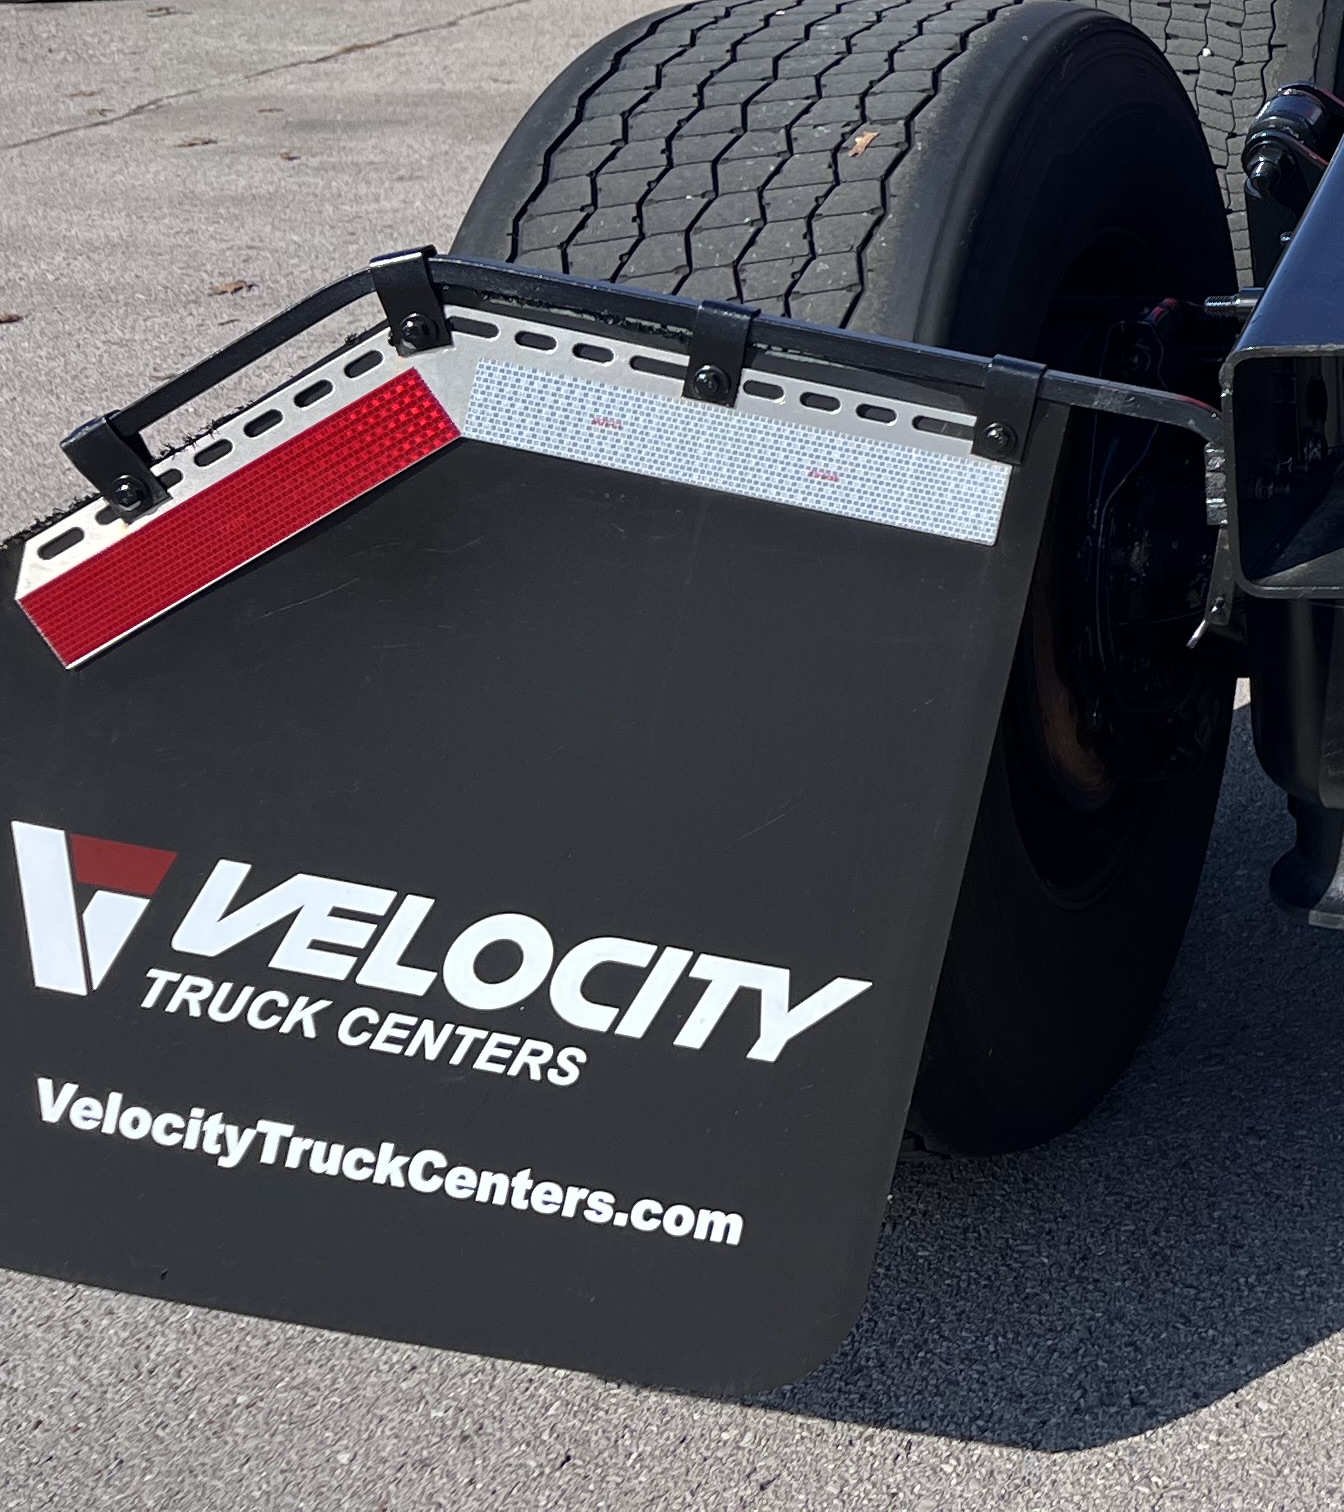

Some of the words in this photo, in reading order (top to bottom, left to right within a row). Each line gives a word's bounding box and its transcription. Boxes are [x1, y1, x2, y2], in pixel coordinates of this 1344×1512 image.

[141, 969, 332, 1038] TRUCK
[338, 1007, 587, 1086] CENTERS
[172, 860, 873, 1062] VELOCITY
[37, 1078, 744, 1246] VelocityTruckCenters.com
